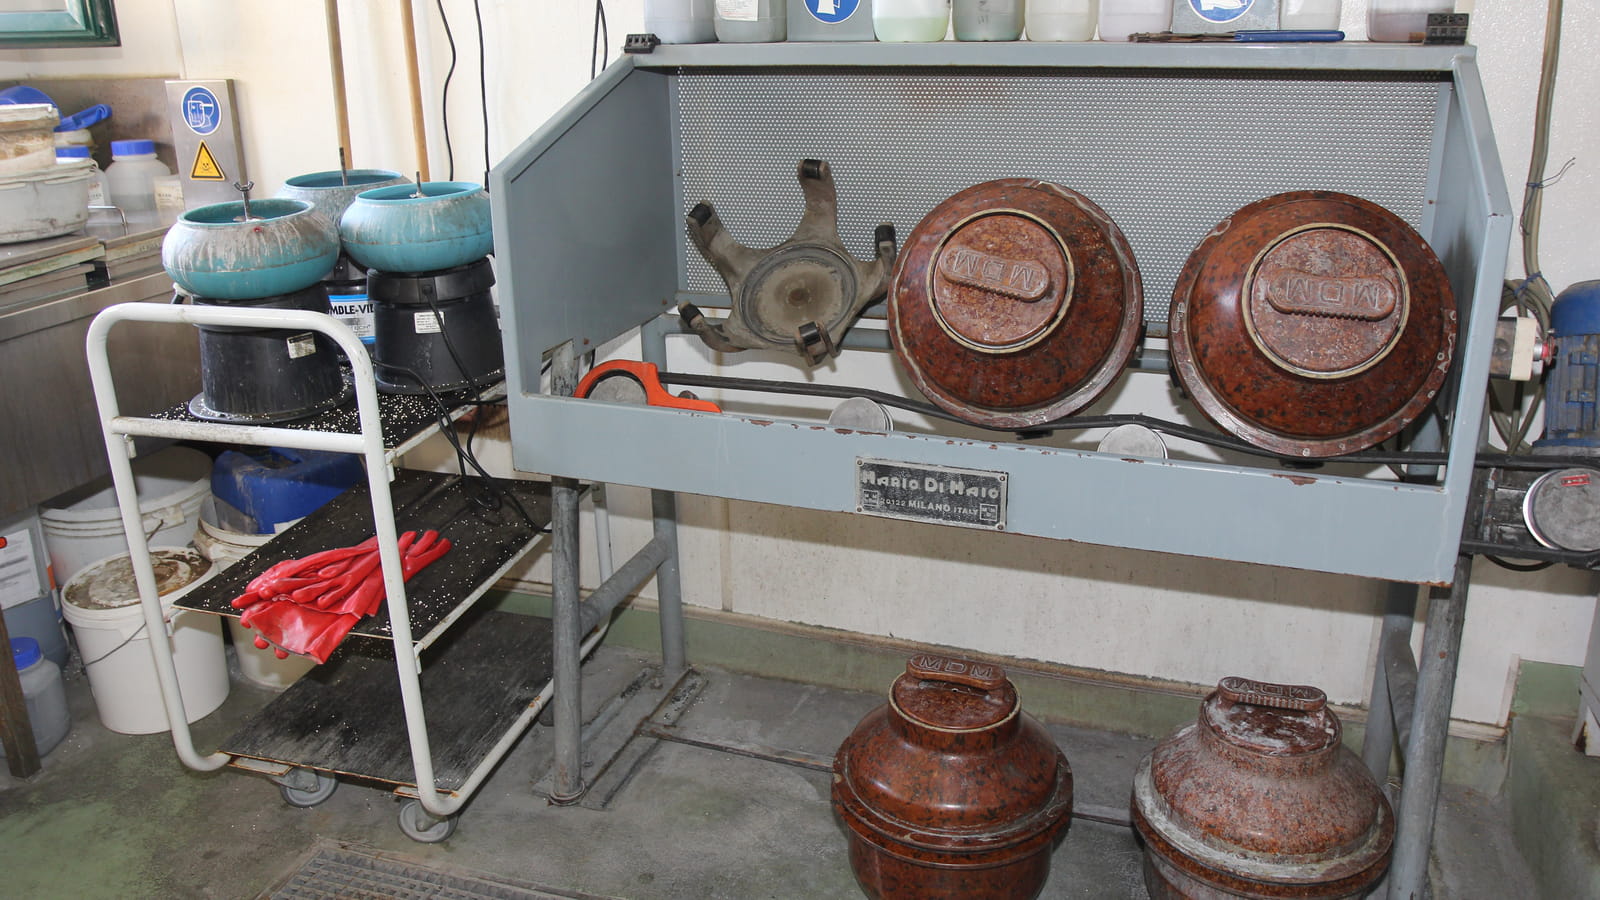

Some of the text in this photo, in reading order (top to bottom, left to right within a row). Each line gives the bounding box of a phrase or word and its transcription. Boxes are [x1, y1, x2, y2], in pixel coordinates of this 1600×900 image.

[908, 500, 951, 512] MILANO
[953, 506, 979, 516] ITALY
[920, 656, 993, 680] MDM
